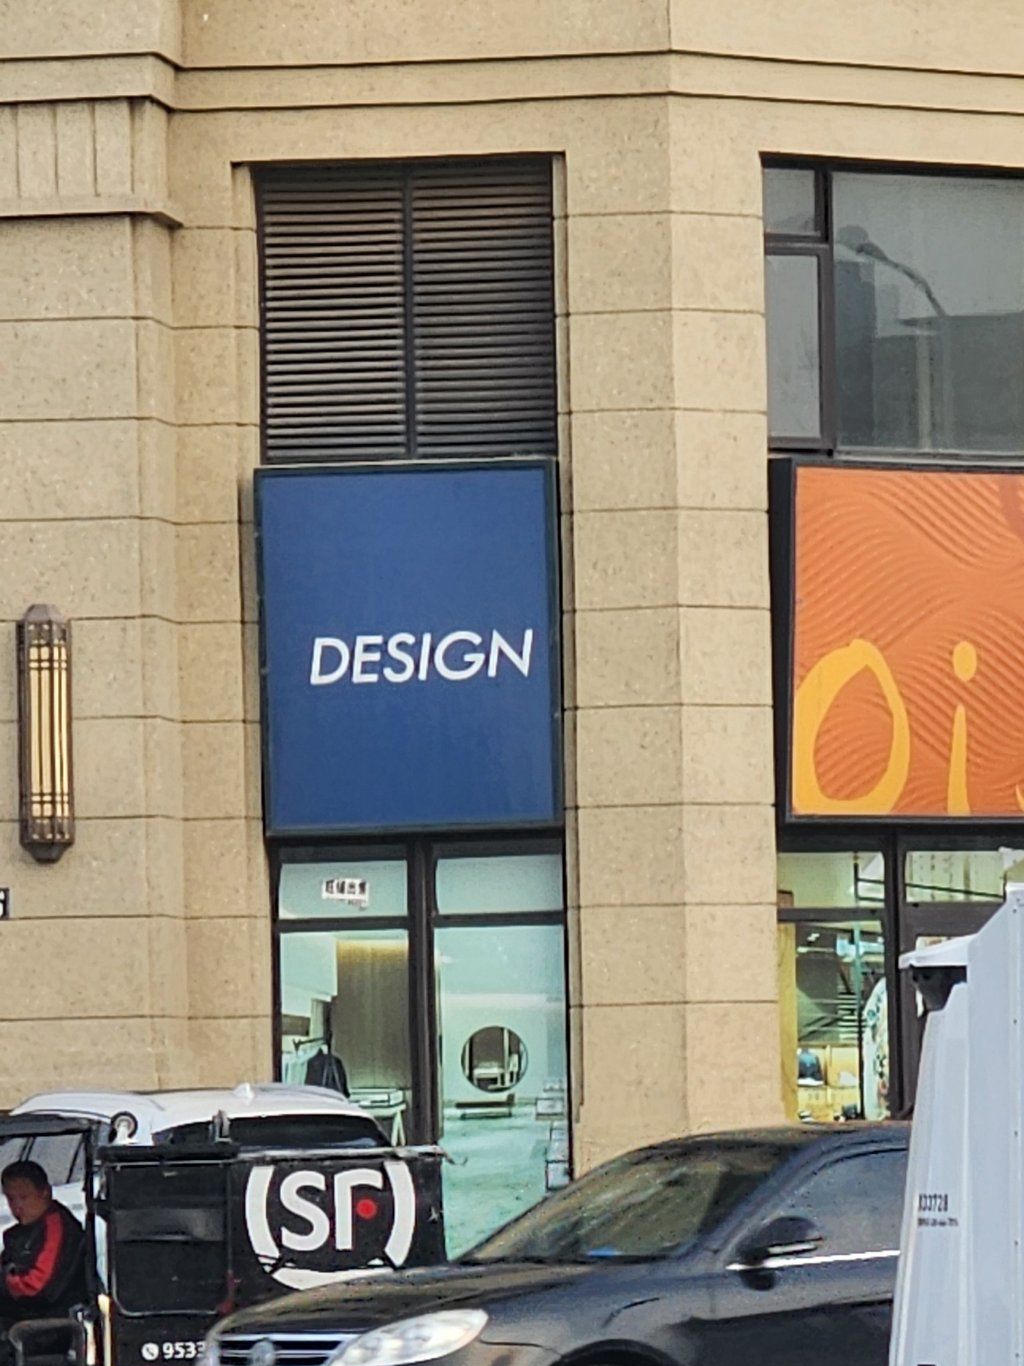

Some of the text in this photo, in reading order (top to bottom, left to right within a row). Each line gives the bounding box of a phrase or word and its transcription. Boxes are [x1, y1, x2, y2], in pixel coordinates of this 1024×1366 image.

[309, 628, 534, 686] DESIGN
[278, 1167, 384, 1252] SF
[162, 1341, 207, 1359] 9533
